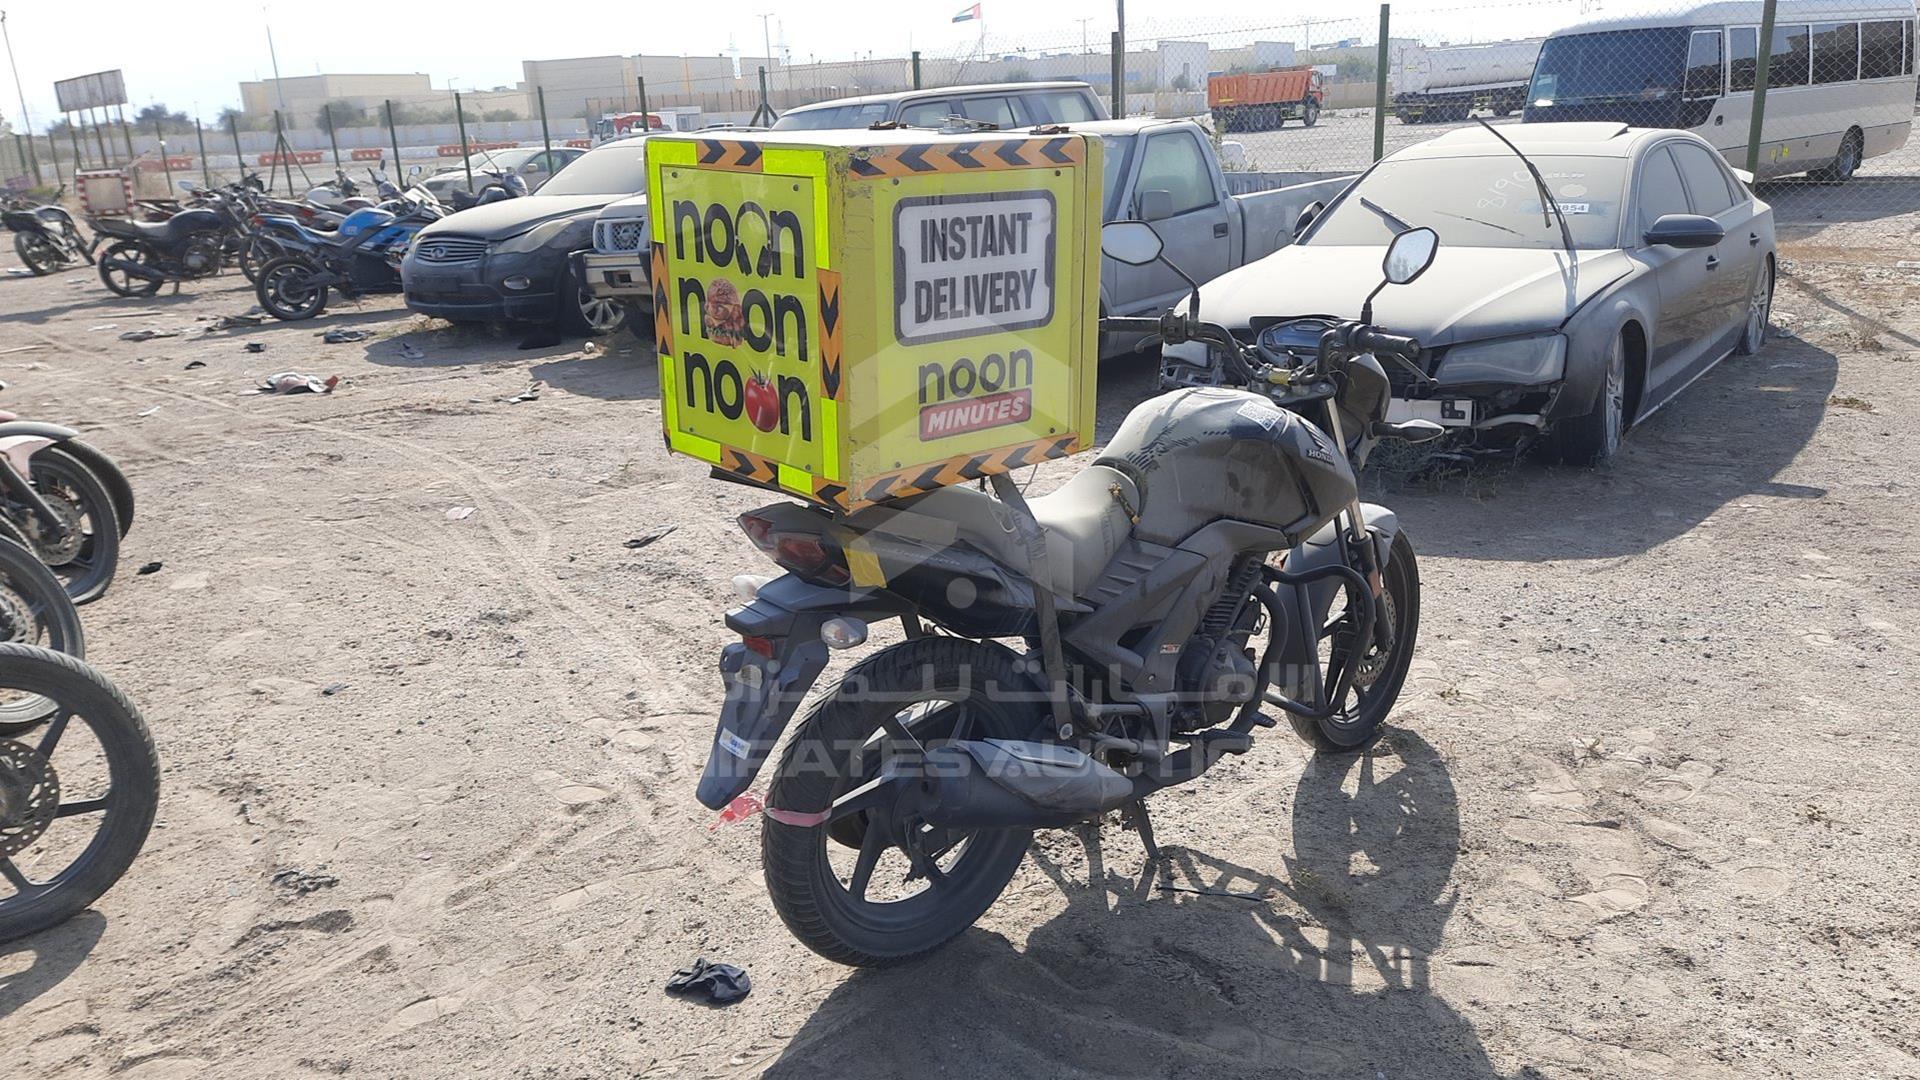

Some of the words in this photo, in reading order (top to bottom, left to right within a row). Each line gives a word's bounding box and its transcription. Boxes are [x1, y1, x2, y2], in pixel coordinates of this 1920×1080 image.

[920, 211, 1033, 264] INSTANT
[678, 276, 808, 362] non
[914, 268, 1038, 325] DELIVERY
[683, 350, 812, 442] non
[918, 348, 1033, 404] noon
[926, 395, 1025, 433] MINUTES
